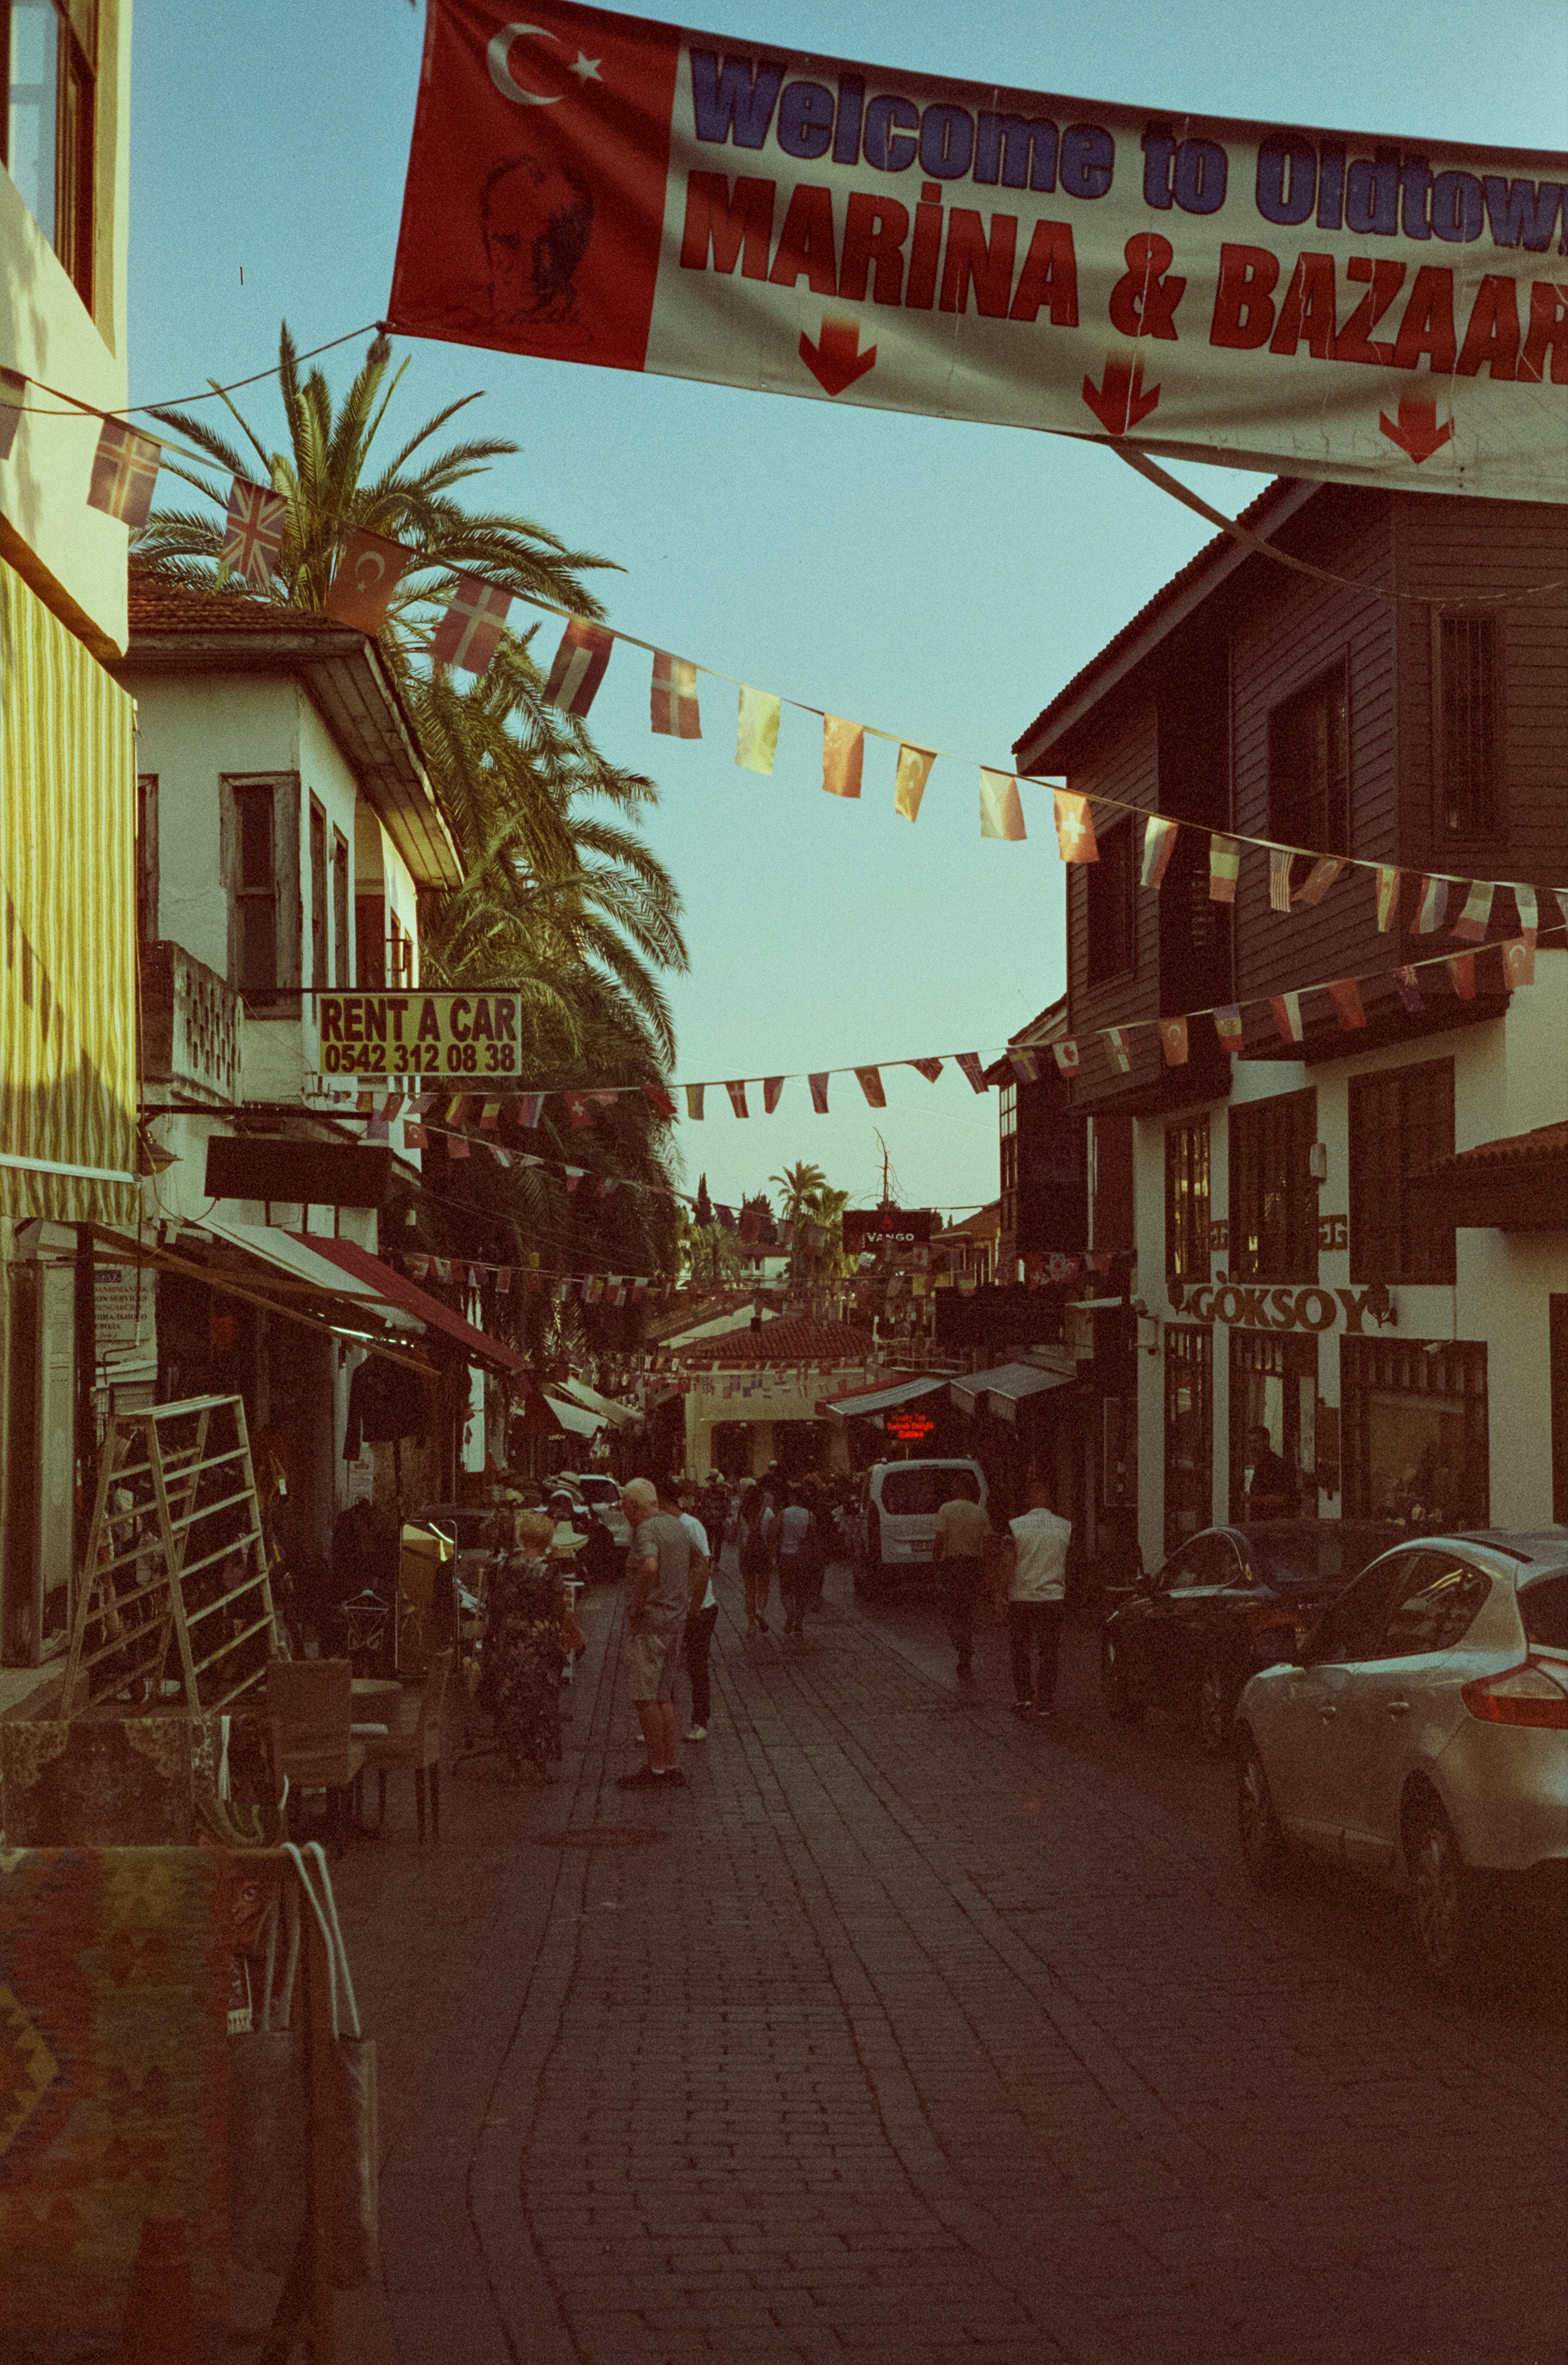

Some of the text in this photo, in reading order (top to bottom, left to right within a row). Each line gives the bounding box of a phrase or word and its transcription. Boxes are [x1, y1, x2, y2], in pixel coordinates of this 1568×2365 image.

[688, 46, 1568, 255] Welcome to Oldtow
[679, 168, 1079, 328] MARİNA
[1109, 231, 1187, 342] &
[320, 997, 516, 1042] RENT A CAR
[324, 1043, 515, 1073] 0542 312 08 38
